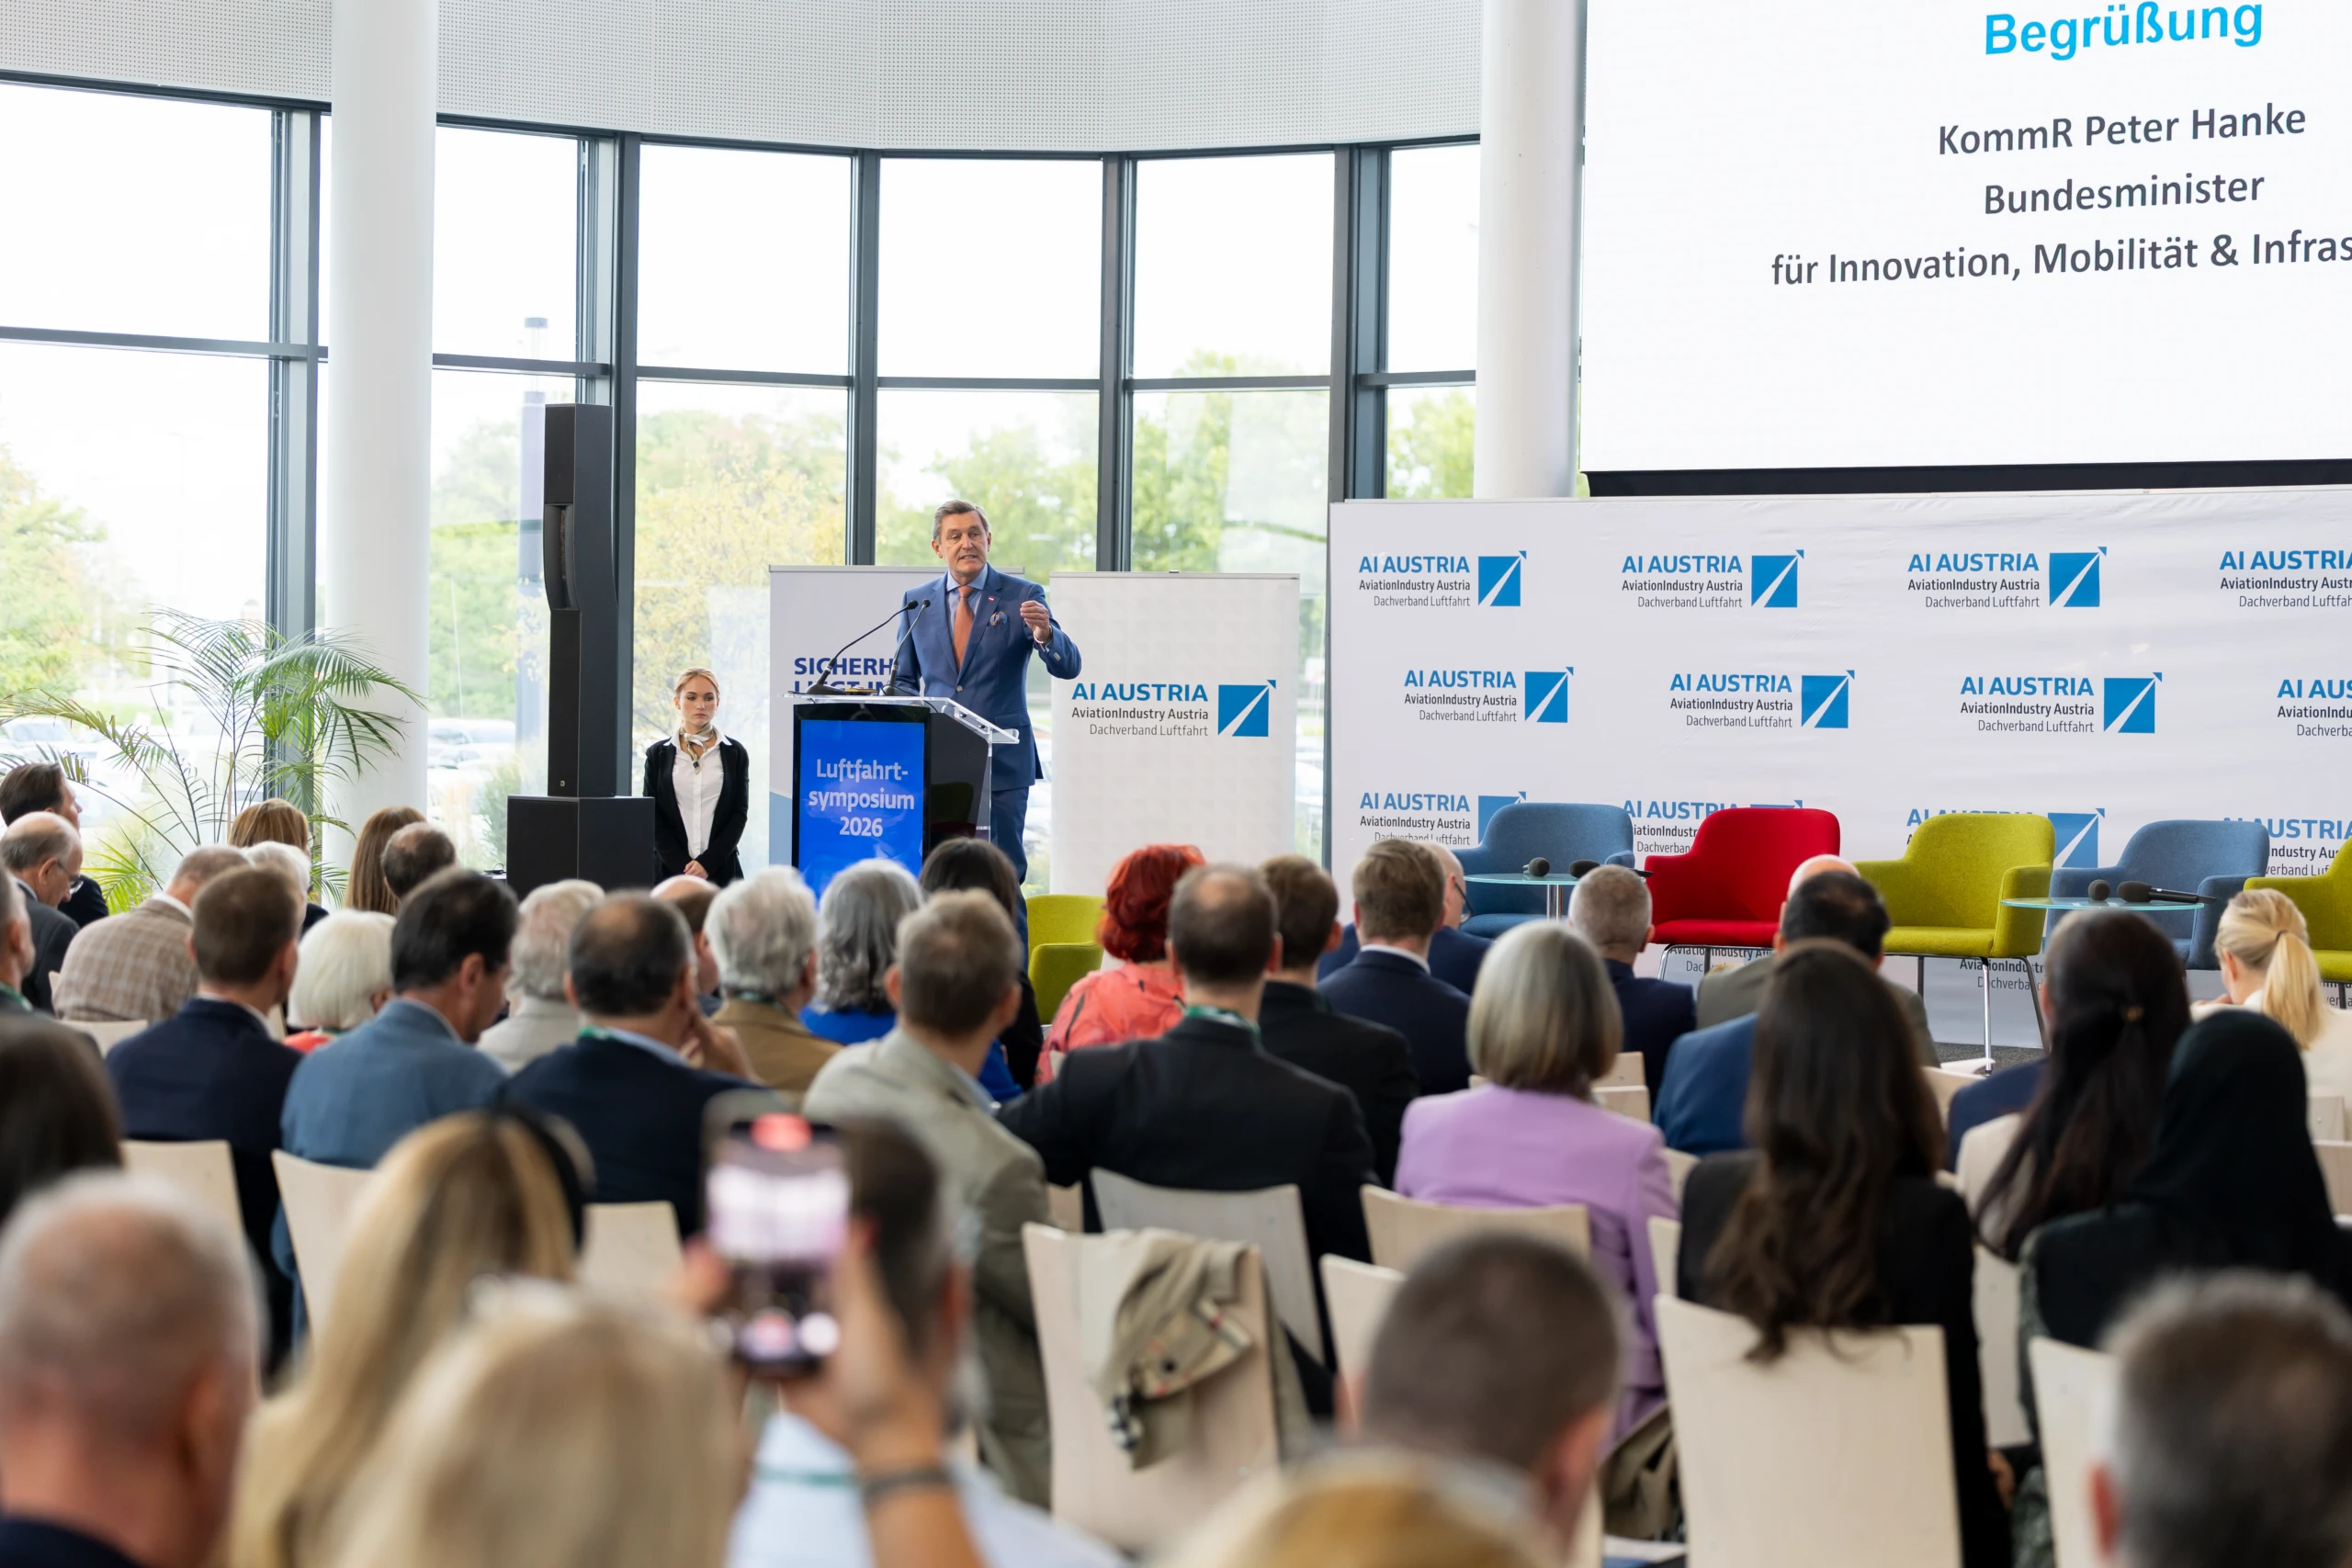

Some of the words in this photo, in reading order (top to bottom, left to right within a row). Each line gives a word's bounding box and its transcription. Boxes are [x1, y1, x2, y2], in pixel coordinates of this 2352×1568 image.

[1985, 1, 2262, 61] Begrüßung
[1939, 118, 2073, 154] KommR
[2086, 115, 2180, 147] Peter
[2192, 103, 2306, 141] Hanke
[1985, 173, 2265, 215] Bundesminister
[1771, 254, 1819, 285] für
[1829, 246, 2020, 283] Innovation,
[2034, 236, 2198, 275] Mobilität
[2211, 233, 2239, 267] &
[2254, 229, 2352, 265] Infras
[1359, 556, 1378, 572] AI
[1383, 556, 1471, 573] AUSTRIA
[1623, 556, 1643, 572] AI
[1648, 556, 1743, 573] AUSTRIA
[1908, 554, 1930, 571] AI
[1936, 553, 2039, 571] AUSTRIA
[2220, 551, 2244, 570] AI
[1360, 580, 1434, 592] AviationIndustry
[1437, 580, 1470, 591] Austria
[1623, 580, 1703, 593] AviationIndustry
[1706, 580, 1743, 591] Austria
[1908, 579, 1997, 592] AviationIndustry
[2000, 579, 2040, 591] Austria
[2221, 577, 2318, 592] AviationIndustry
[1374, 596, 1428, 606] Dachverband
[1430, 596, 1470, 607] Luftfahrt
[1638, 596, 1697, 607] Dachverband
[1700, 596, 1743, 607] Luftfahrt
[1926, 596, 1990, 607] Dachverband
[1993, 596, 2040, 607] Luftfahrt
[2239, 595, 2310, 606] Dachverband
[1404, 671, 1423, 686] AI
[1429, 671, 1517, 688] AUSTRIA
[1670, 674, 1691, 691] AI
[1696, 674, 1792, 693] AUSTRIA
[1961, 677, 1984, 694] AI
[1989, 677, 2094, 695] AUSTRIA
[1072, 683, 1095, 700] AI
[1101, 683, 1208, 702] AUSTRIA
[2278, 680, 2302, 698] AI
[1405, 694, 1480, 707] AviationIndustry
[1483, 694, 1517, 705] Austria
[1670, 698, 1753, 713] AviationIndustry
[1756, 699, 1792, 710] Austria
[1072, 707, 1165, 721] AviationIndustry
[1168, 709, 1209, 719] Austria
[1419, 710, 1474, 721] Dachverband
[1477, 711, 1517, 722] Luftfahrt
[1961, 702, 2051, 717] AviationIndustry
[2053, 704, 2094, 715] Austria
[1091, 724, 1157, 735] Dachverband
[1160, 725, 1209, 736] Luftfahrt
[1687, 716, 1746, 727] Dachverband
[1748, 716, 1792, 728] Luftfahrt
[1978, 720, 2043, 731] Dachverband
[2047, 721, 2094, 732] Luftfahrt
[817, 758, 908, 783] Luftfahrt-
[808, 787, 914, 812] symposium
[1360, 793, 1379, 809] AI
[1384, 794, 1470, 812] AUSTRIA
[1646, 801, 1737, 819] AUSTR
[839, 816, 883, 837] 2026
[1361, 816, 1435, 830] AviationIndustry
[1437, 818, 1470, 829] Austria
[1637, 841, 1693, 853] Dachverban
